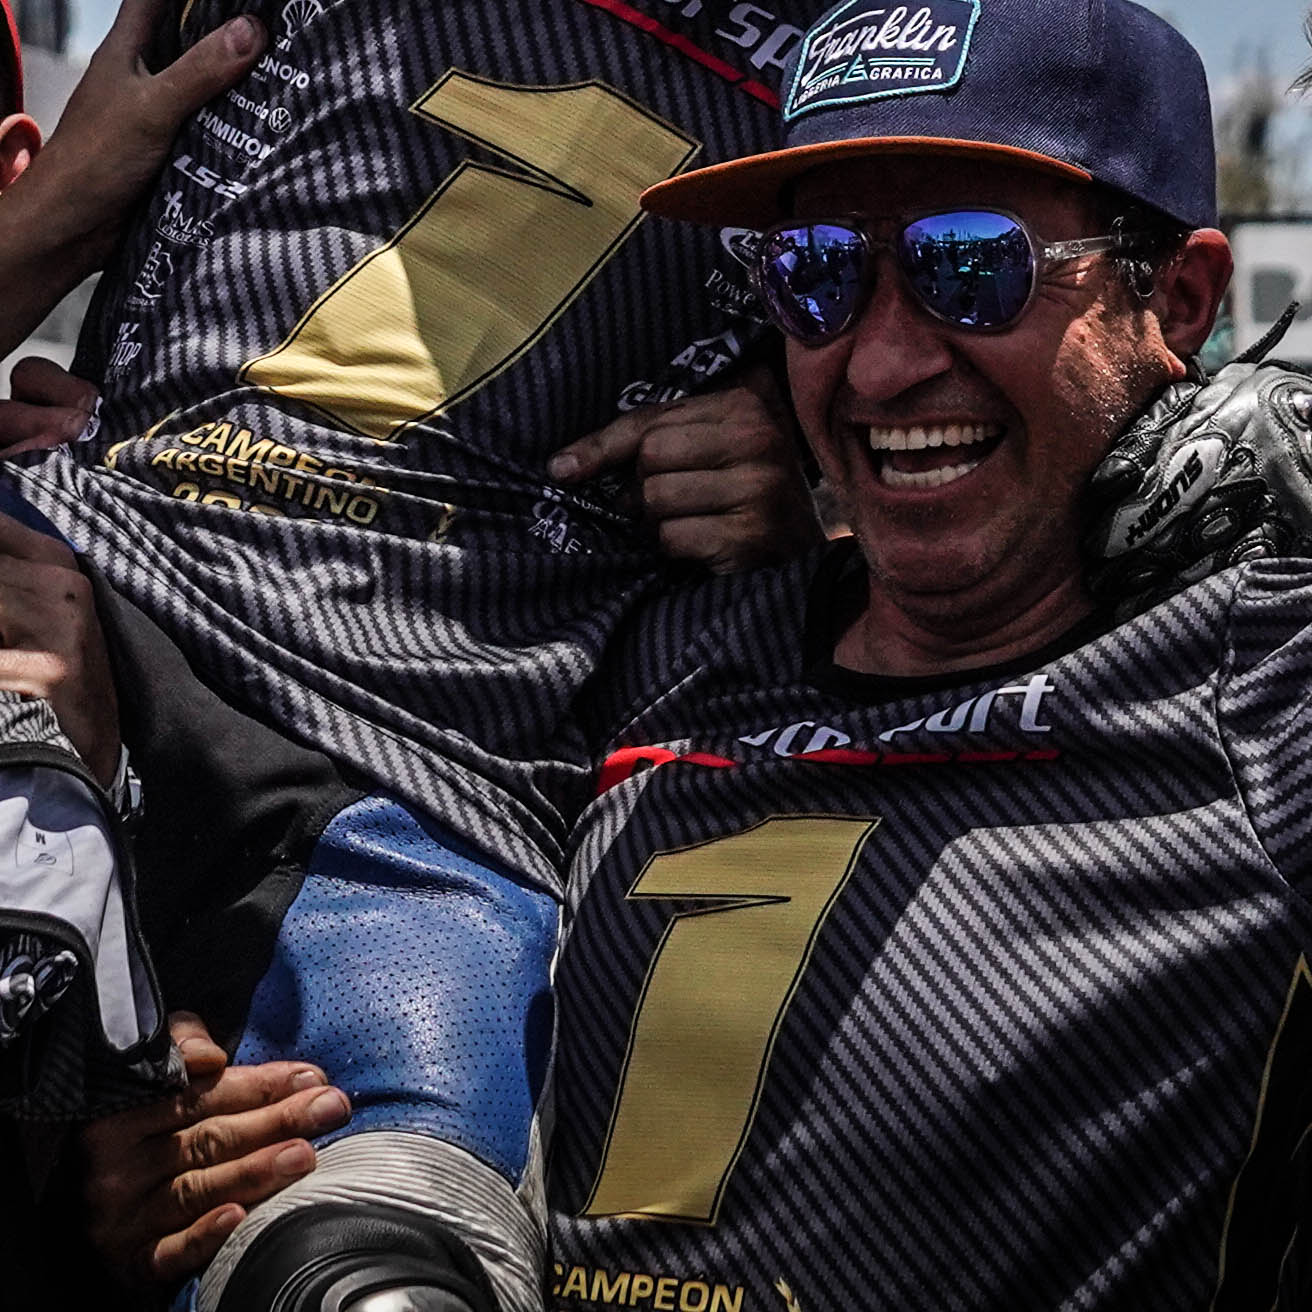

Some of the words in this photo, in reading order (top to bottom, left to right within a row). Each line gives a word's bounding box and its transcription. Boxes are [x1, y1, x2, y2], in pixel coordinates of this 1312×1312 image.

[801, 6, 957, 88] Franklin
[869, 67, 943, 81] GRAFICA
[196, 106, 276, 161] HAMILTON
[172, 154, 250, 199] LS2
[239, 67, 703, 442] 1
[150, 447, 381, 526] ARGENTINO
[577, 814, 882, 1228] 1
